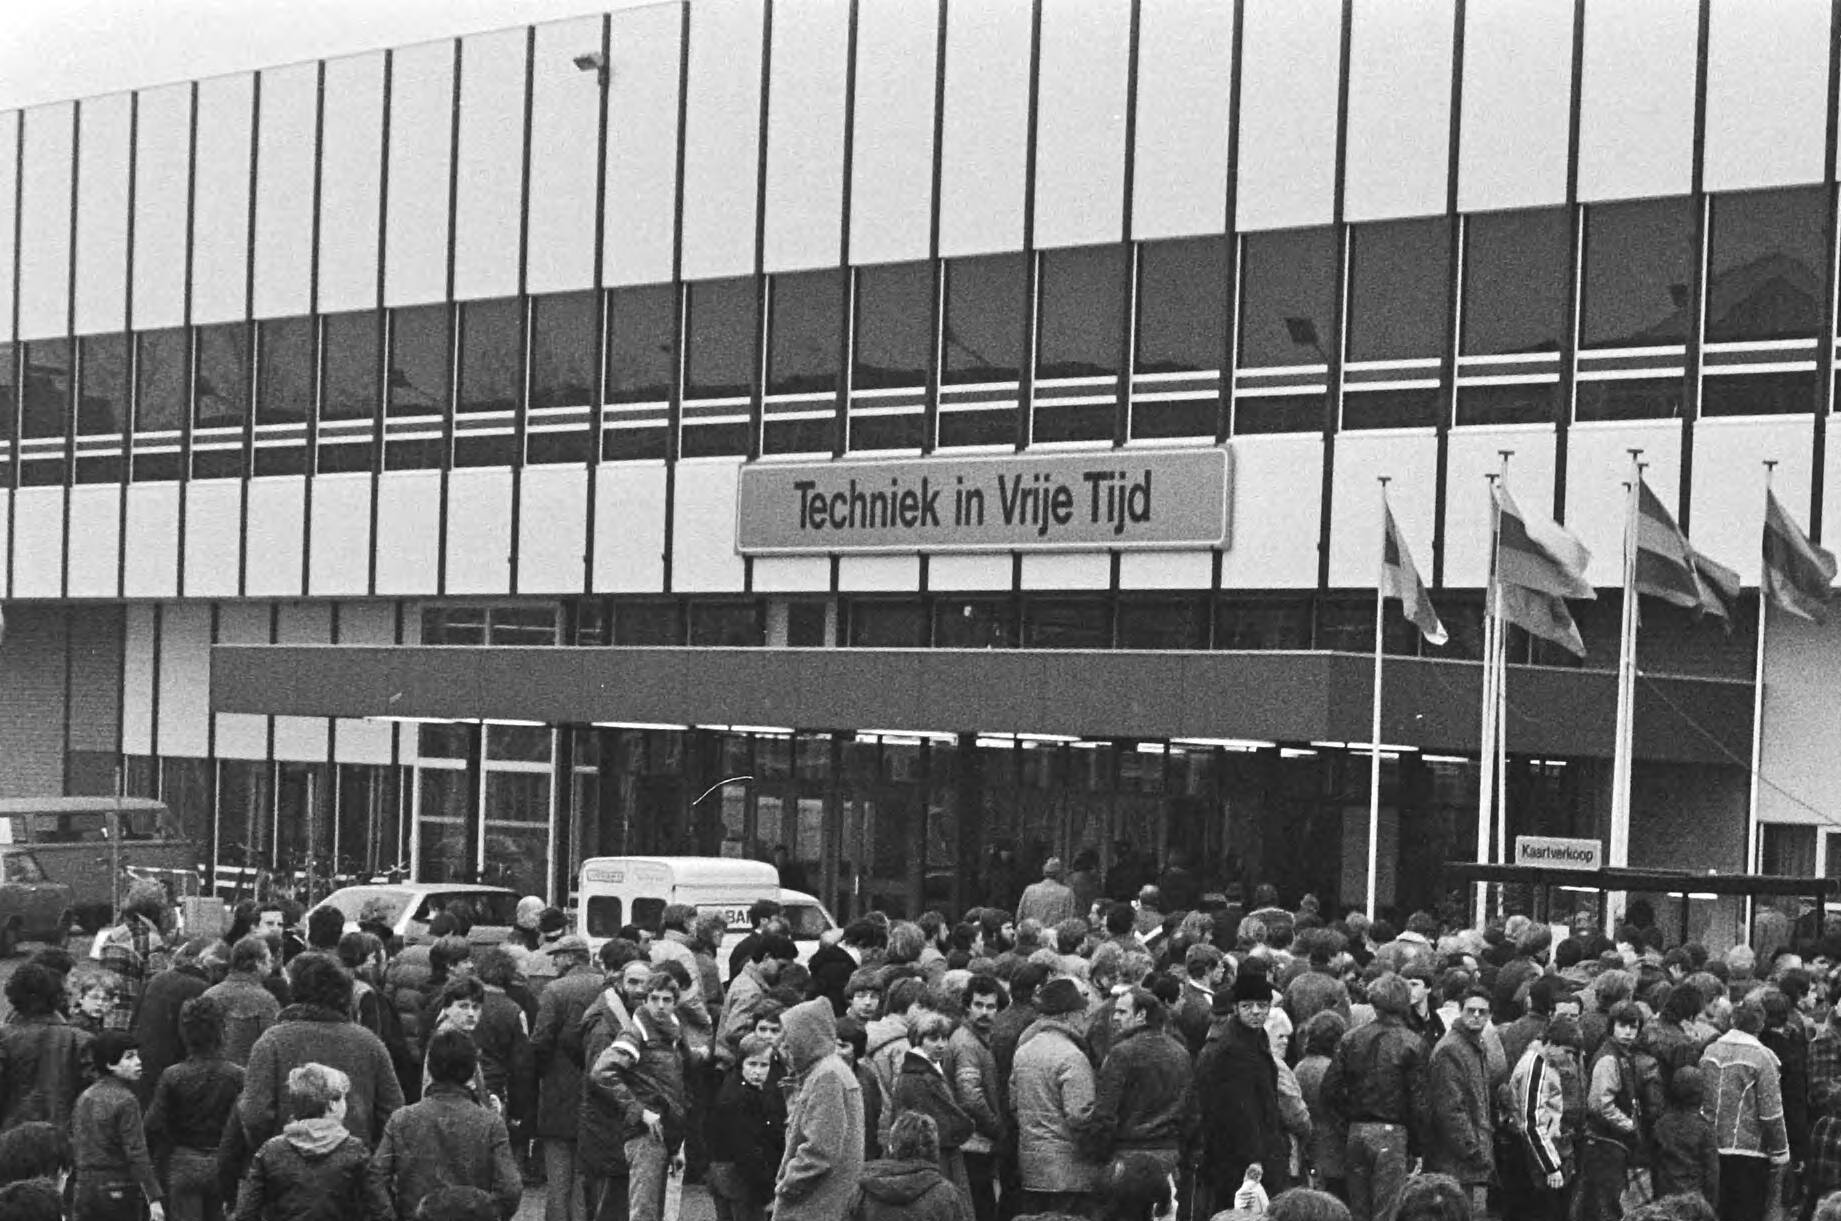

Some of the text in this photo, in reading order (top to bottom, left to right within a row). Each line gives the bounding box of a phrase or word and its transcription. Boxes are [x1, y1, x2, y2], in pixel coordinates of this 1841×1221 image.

[793, 469, 1152, 537] Techniek in Vrije Tijd
[1521, 843, 1594, 863] Kaartverkoop
